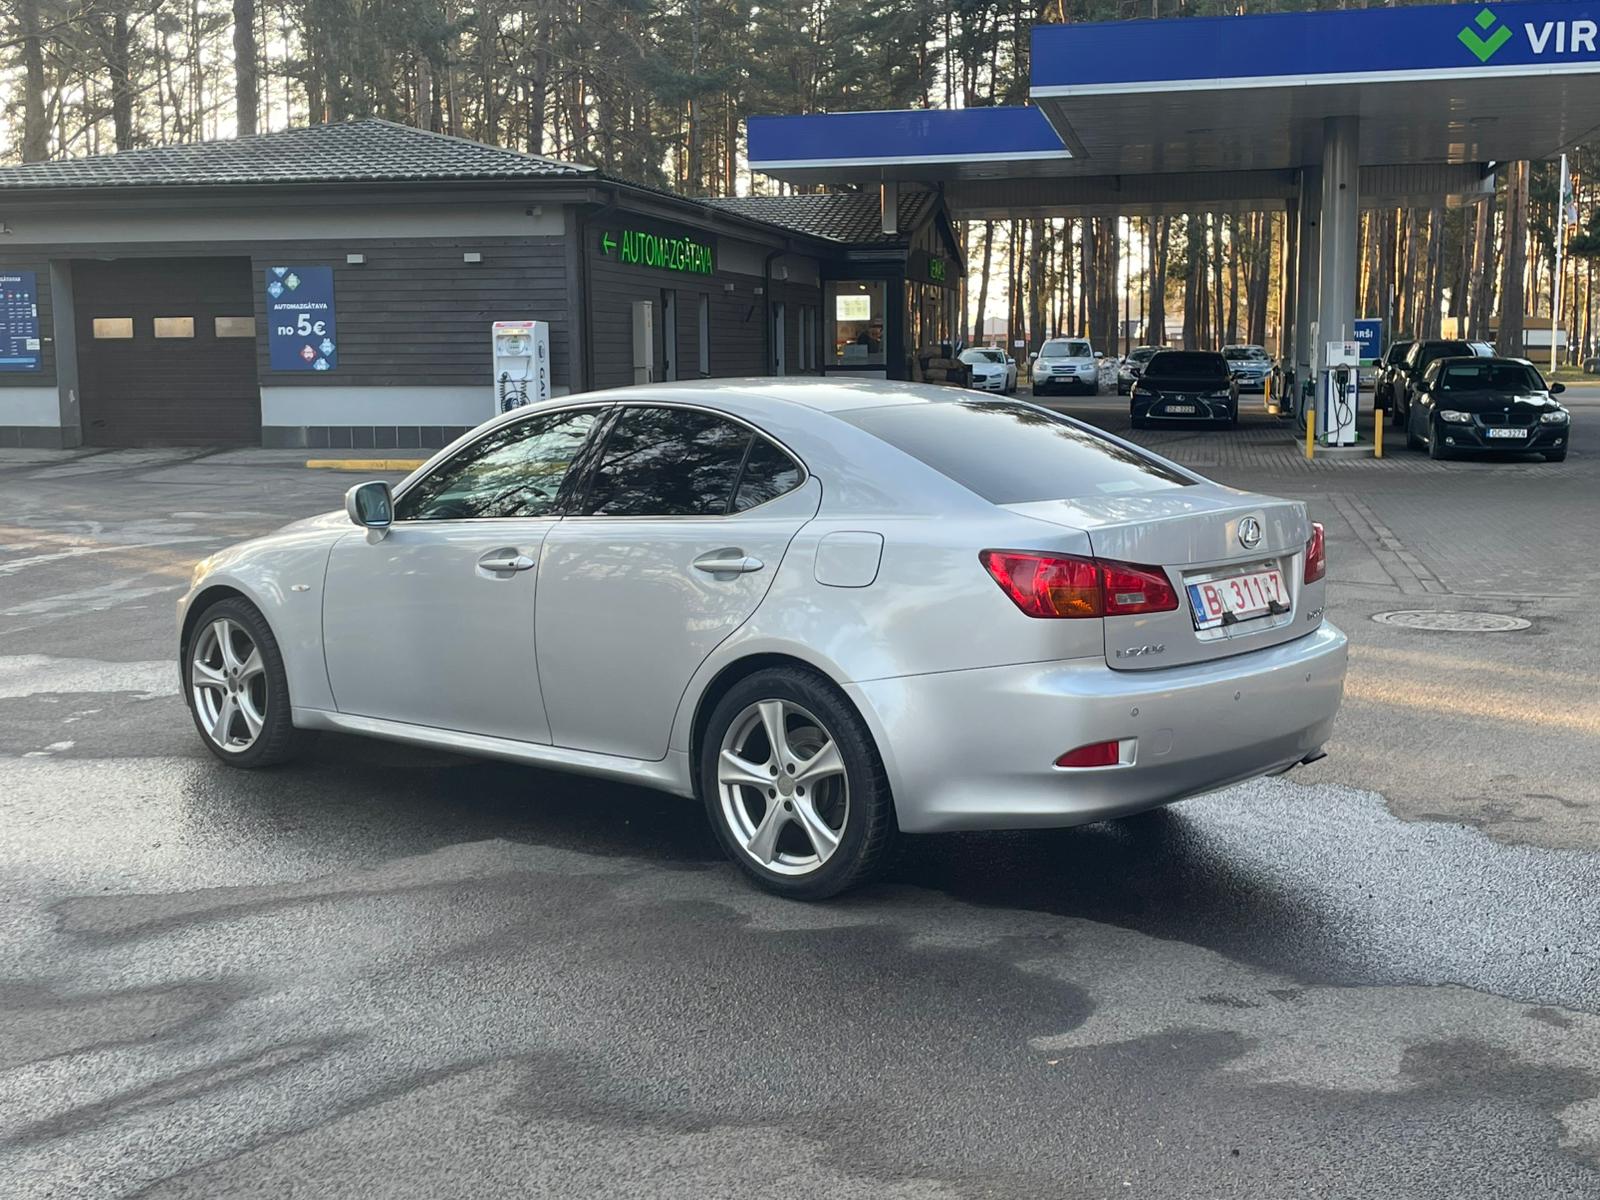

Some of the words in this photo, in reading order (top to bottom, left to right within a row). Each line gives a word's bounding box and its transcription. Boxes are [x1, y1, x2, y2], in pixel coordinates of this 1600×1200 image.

[1524, 20, 1598, 54] VIR
[622, 230, 712, 274] AUTOMAZGĀTAVA
[273, 301, 329, 311] AUTOMAZGĀTAVA
[277, 325, 295, 336] no
[297, 313, 327, 337] 5€
[1203, 585, 1222, 615] B
[1230, 574, 1280, 609] 3117
